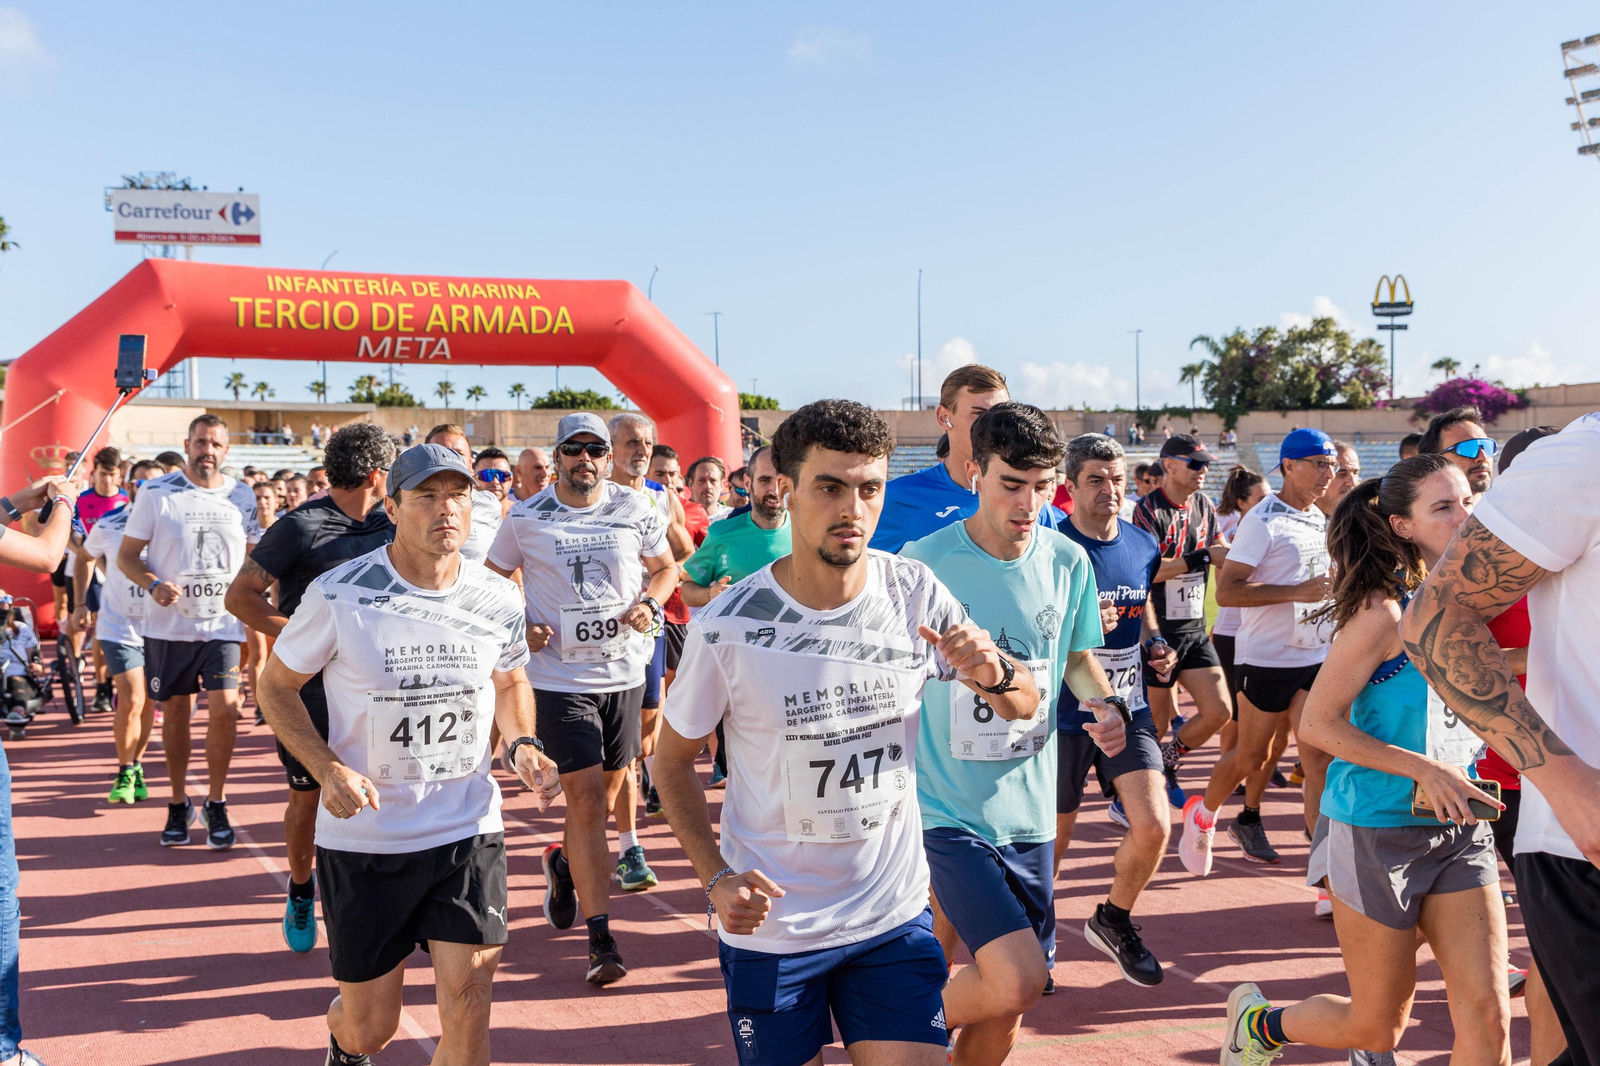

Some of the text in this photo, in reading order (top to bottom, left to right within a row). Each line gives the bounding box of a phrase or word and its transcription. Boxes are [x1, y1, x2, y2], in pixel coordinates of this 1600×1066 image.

[118, 202, 212, 220] Carrefour
[266, 275, 541, 300] INFANTERÍA DE MARINA
[229, 296, 575, 334] TERCIO DE ARMADA
[356, 335, 452, 360] META
[555, 534, 618, 546] MEMORIAL
[183, 583, 224, 598] 1062
[575, 617, 618, 642] 639
[385, 644, 477, 657] MEMORIAL
[385, 656, 423, 666] SARGENTO
[396, 664, 424, 672] MARINA
[784, 677, 895, 707] MEMORIAL
[785, 692, 895, 717] SARGENTO DE INFANTERIA
[787, 701, 896, 726] DE MARINA CARMONA PAEZ
[389, 711, 457, 748] 412
[799, 733, 825, 741] MEMORIAL
[825, 729, 849, 739] SARGENTO
[886, 716, 902, 726] MARINA
[823, 739, 841, 747] RAFAEL
[842, 735, 861, 744] CARMONA
[809, 747, 884, 798] 747
[817, 807, 844, 815] SANTIAGO
